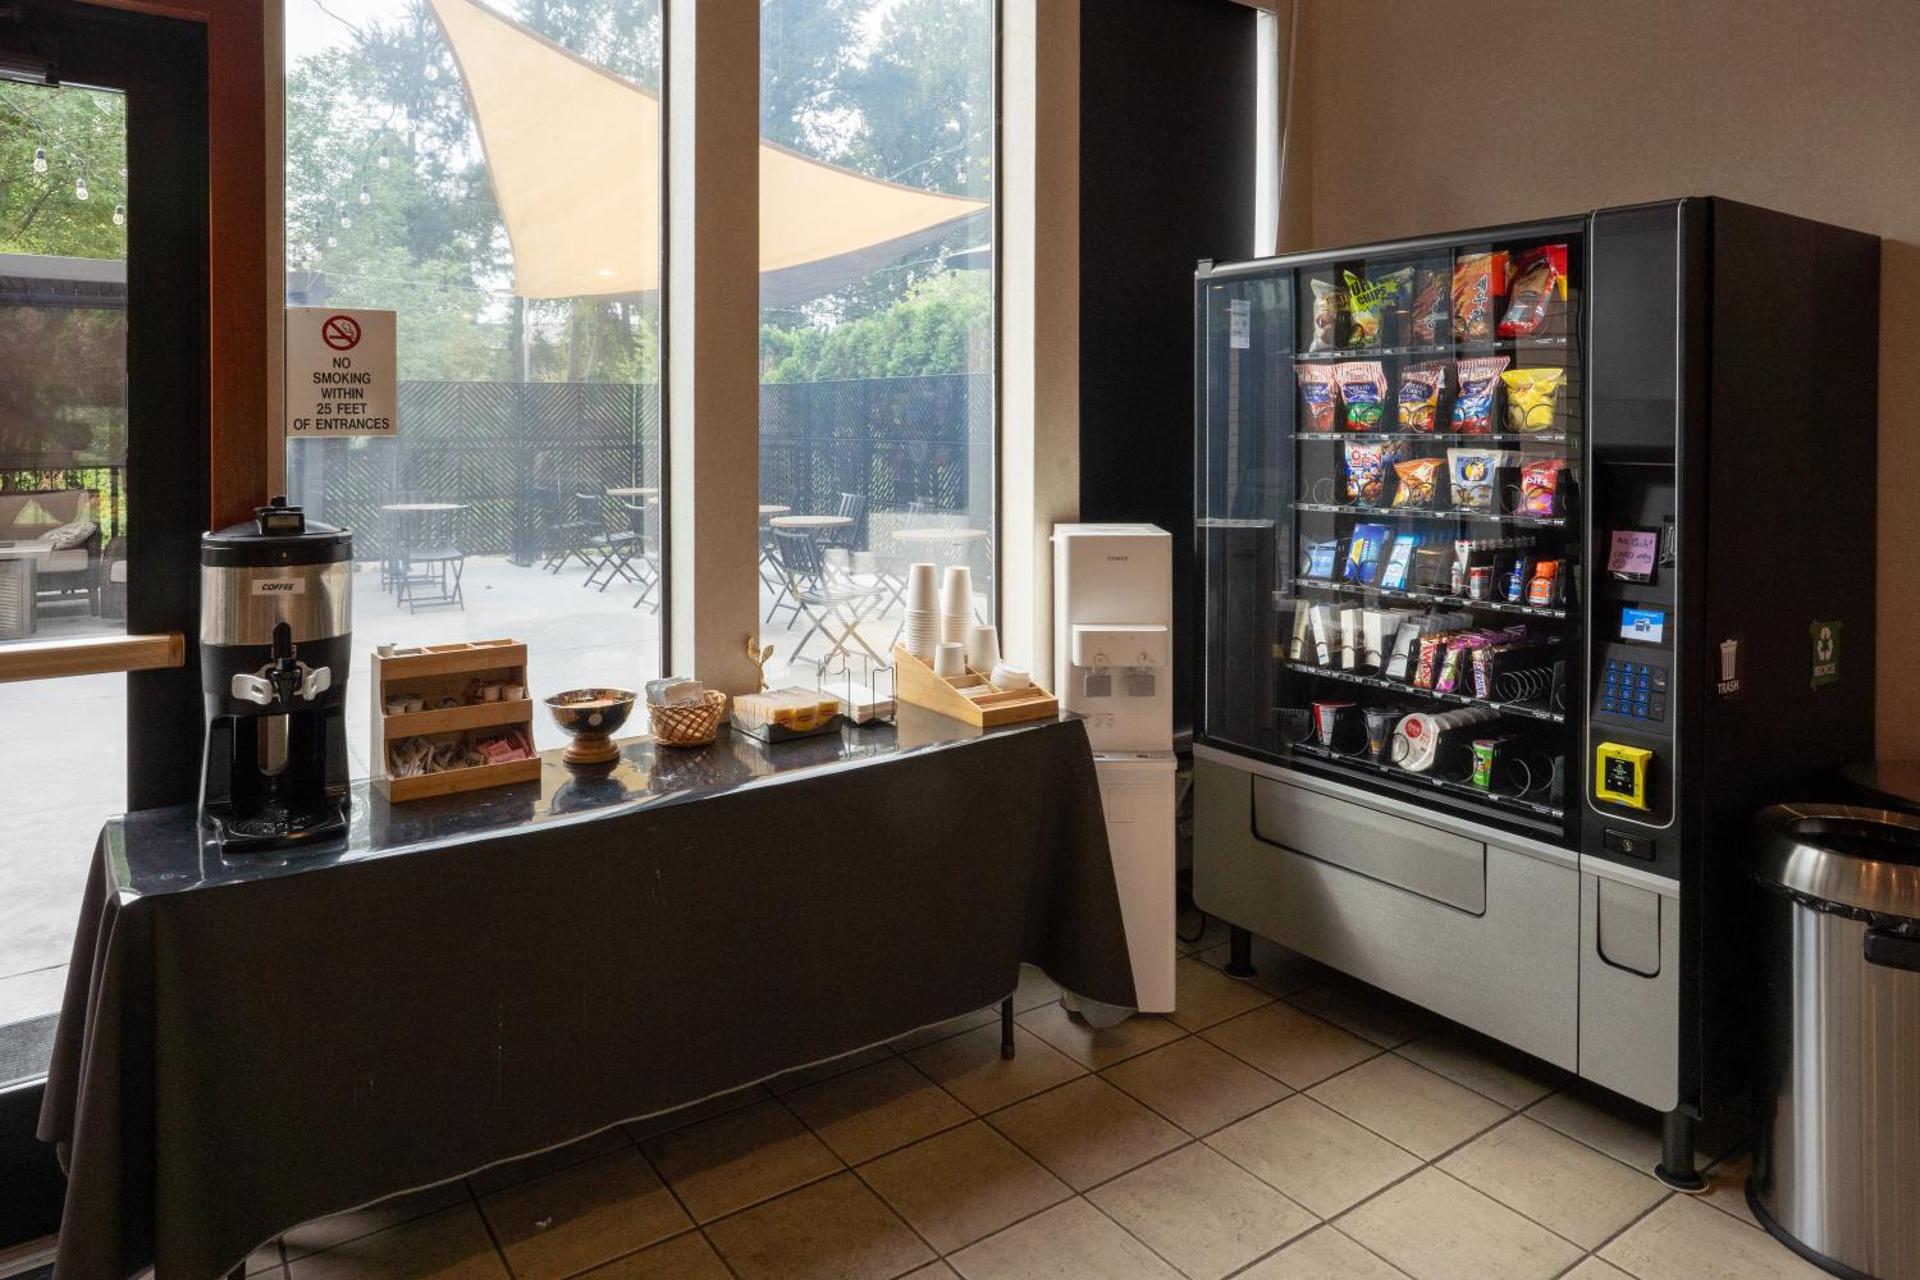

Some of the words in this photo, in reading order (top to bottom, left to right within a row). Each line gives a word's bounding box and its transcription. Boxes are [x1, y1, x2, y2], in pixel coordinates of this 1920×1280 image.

[332, 357, 351, 369] NO
[312, 372, 372, 385] SMOKING
[321, 387, 364, 399] WITHIN
[316, 402, 332, 415] 25
[337, 402, 368, 415] FEET
[293, 418, 311, 431] OF
[315, 417, 390, 430] ENTRANCES
[261, 583, 295, 591] COFFEE
[1716, 679, 1740, 695] TRASH
